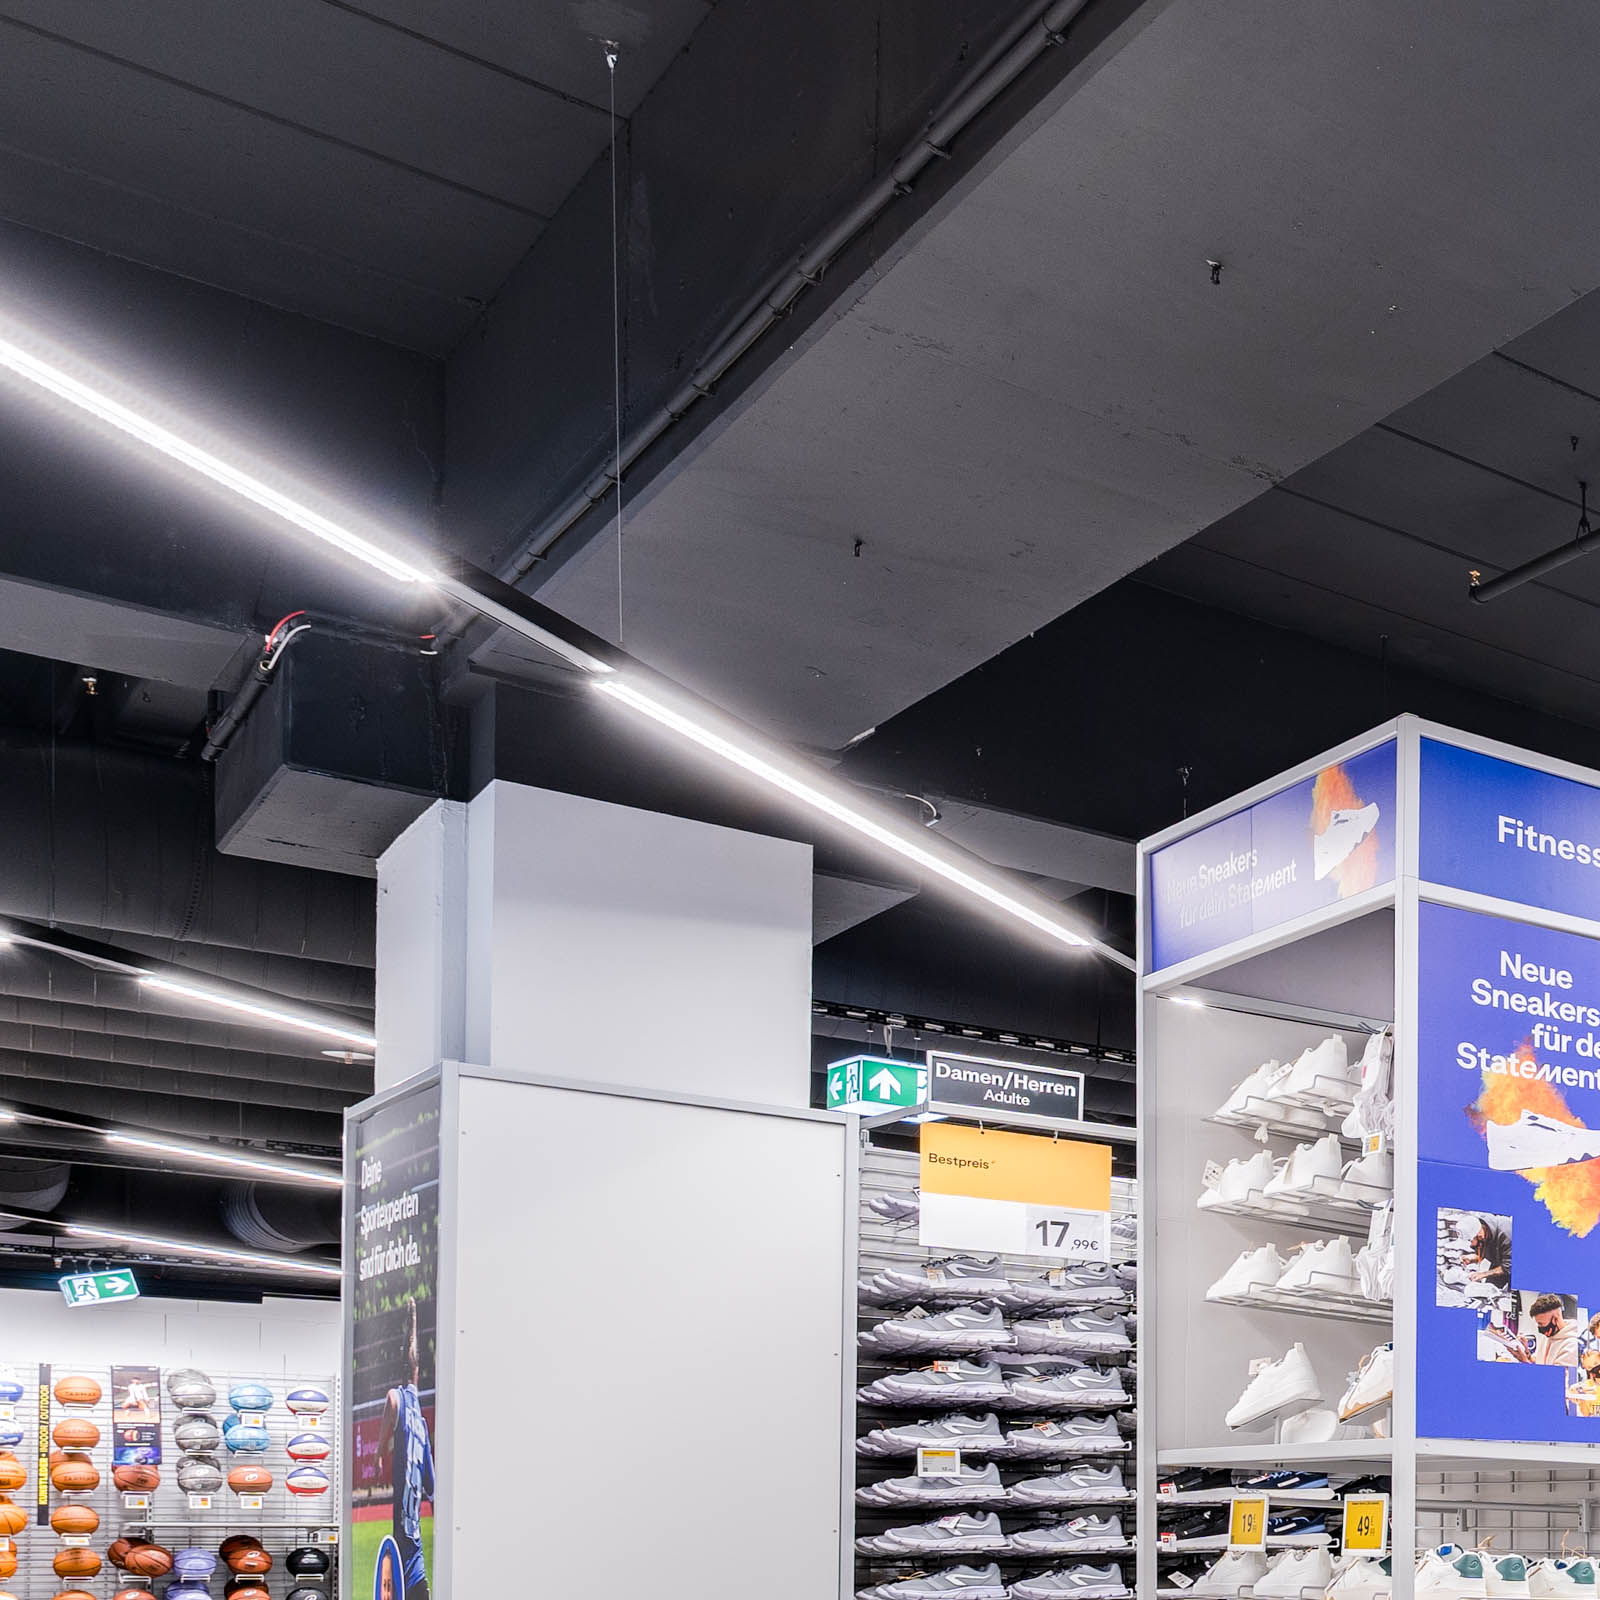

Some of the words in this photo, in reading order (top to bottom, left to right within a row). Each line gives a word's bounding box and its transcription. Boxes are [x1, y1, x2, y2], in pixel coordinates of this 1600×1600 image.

[1167, 876, 1197, 904] Neue
[1199, 849, 1258, 888] Sneakers
[1180, 903, 1196, 928] für
[1500, 950, 1573, 990] Neue
[1471, 978, 1600, 1028] Sneakers
[1531, 1023, 1572, 1053] für
[935, 1062, 1077, 1097] Damen/Herren
[983, 1089, 1031, 1106] Adulte
[361, 1156, 382, 1190] Deine
[928, 1153, 990, 1170] Bestpreis
[360, 1191, 419, 1240] Sportexperten
[359, 1248, 374, 1281] sind
[374, 1245, 386, 1275] für
[385, 1238, 405, 1272] dich
[405, 1234, 421, 1266] da.
[40, 1384, 49, 1420] OUTDOOR
[39, 1425, 49, 1453] INDOOR
[38, 1457, 48, 1505] KUNSTLEDER
[1242, 1514, 1253, 1533] 19
[1357, 1515, 1370, 1537] 49
